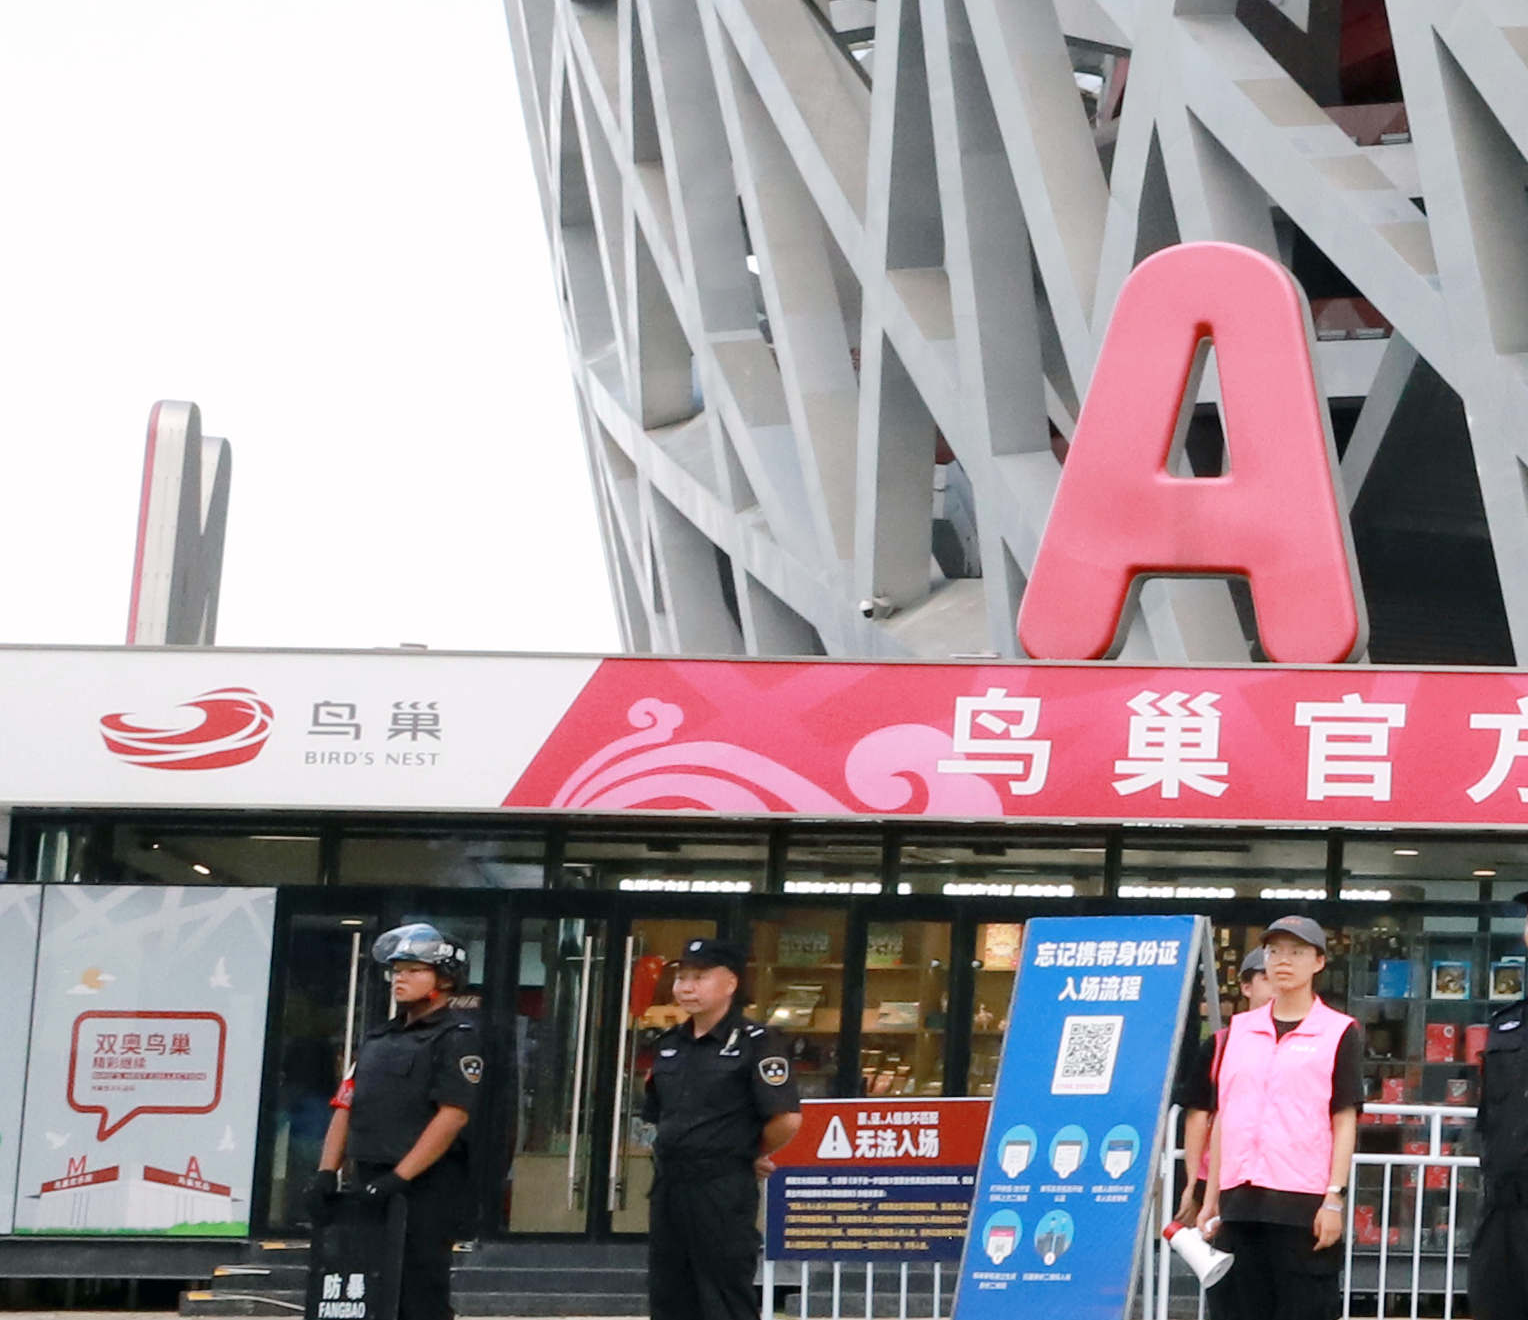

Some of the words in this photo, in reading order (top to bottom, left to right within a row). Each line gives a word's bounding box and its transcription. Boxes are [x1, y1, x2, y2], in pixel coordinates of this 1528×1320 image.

[1017, 241, 1368, 662] A
[306, 700, 441, 741] 鸟巢
[305, 751, 375, 765] BIRD'S
[386, 752, 440, 766] NEST
[1034, 940, 1181, 968] 忘记携带身份证
[1058, 975, 1143, 1002] 入场流程
[94, 1033, 191, 1055] 双奥鸟巢
[856, 1129, 939, 1158] 无法入场
[318, 1302, 366, 1318] FANGBAO
